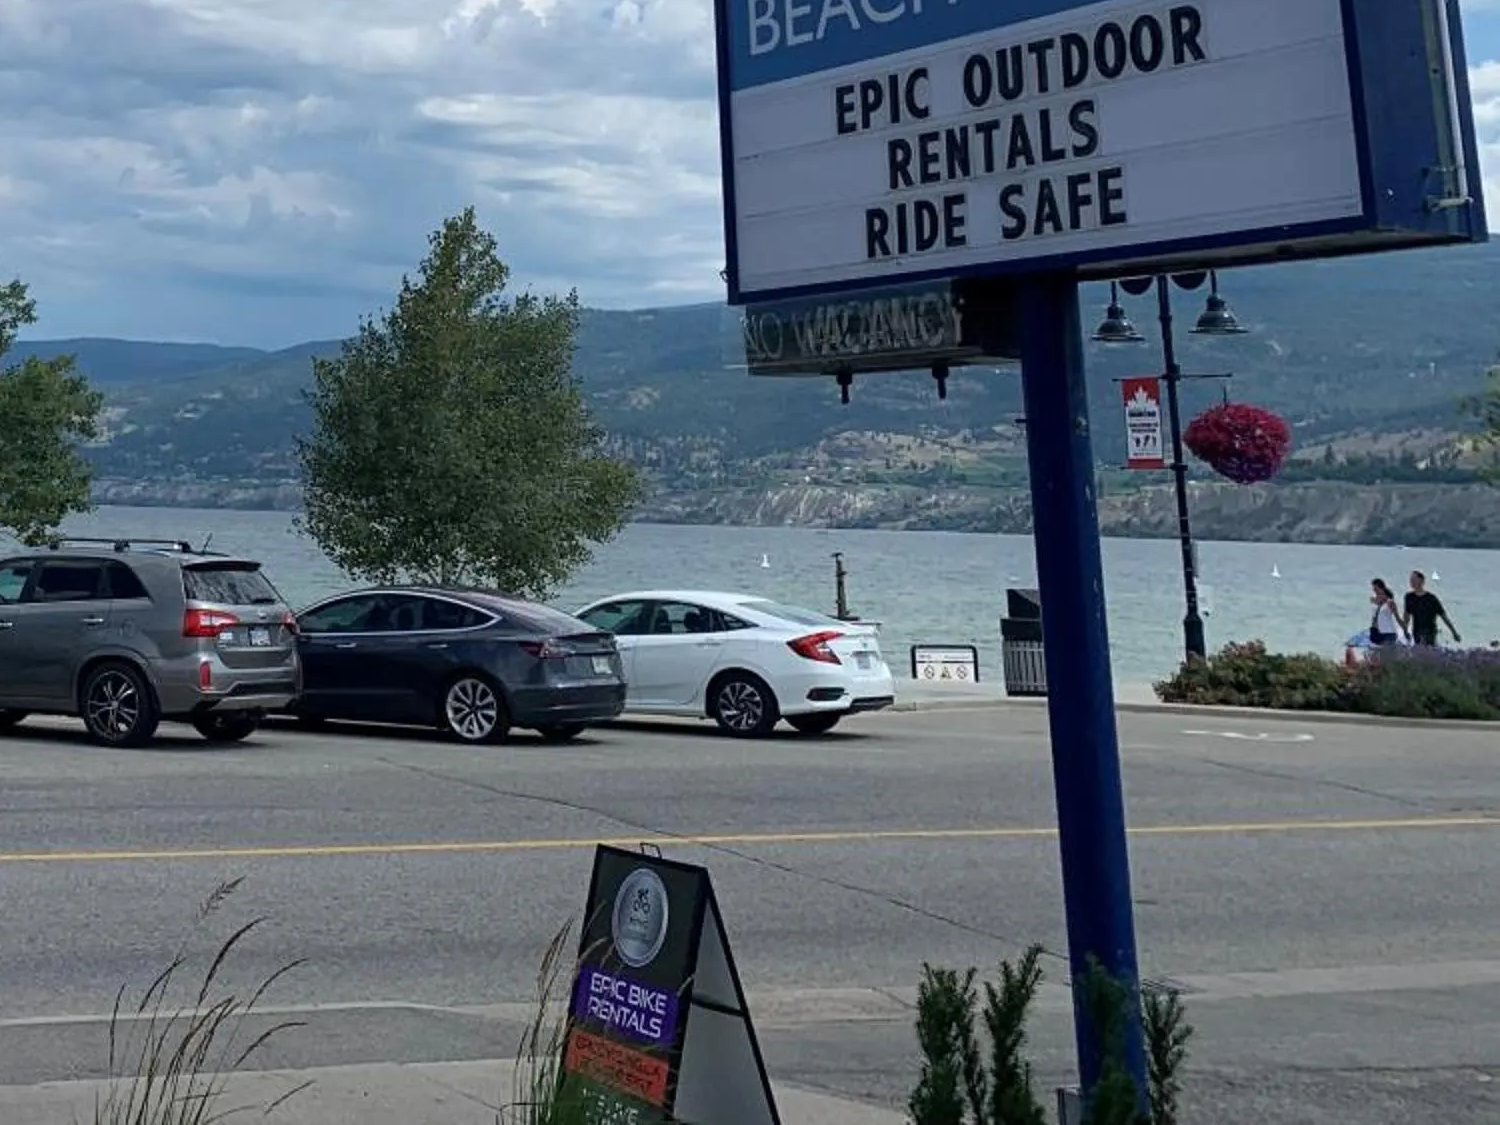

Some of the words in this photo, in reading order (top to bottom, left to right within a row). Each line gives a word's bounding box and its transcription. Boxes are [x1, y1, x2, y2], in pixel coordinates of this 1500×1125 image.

[835, 68, 930, 135] EPIC
[963, 5, 1206, 108] OUTDOOR
[889, 100, 1100, 189] RENTALS
[866, 194, 967, 260] RIDE
[1001, 167, 1127, 240] SAFE
[587, 996, 662, 1039] RENTALS
[590, 972, 627, 1001] EPIC
[627, 984, 668, 1016] BIKE
